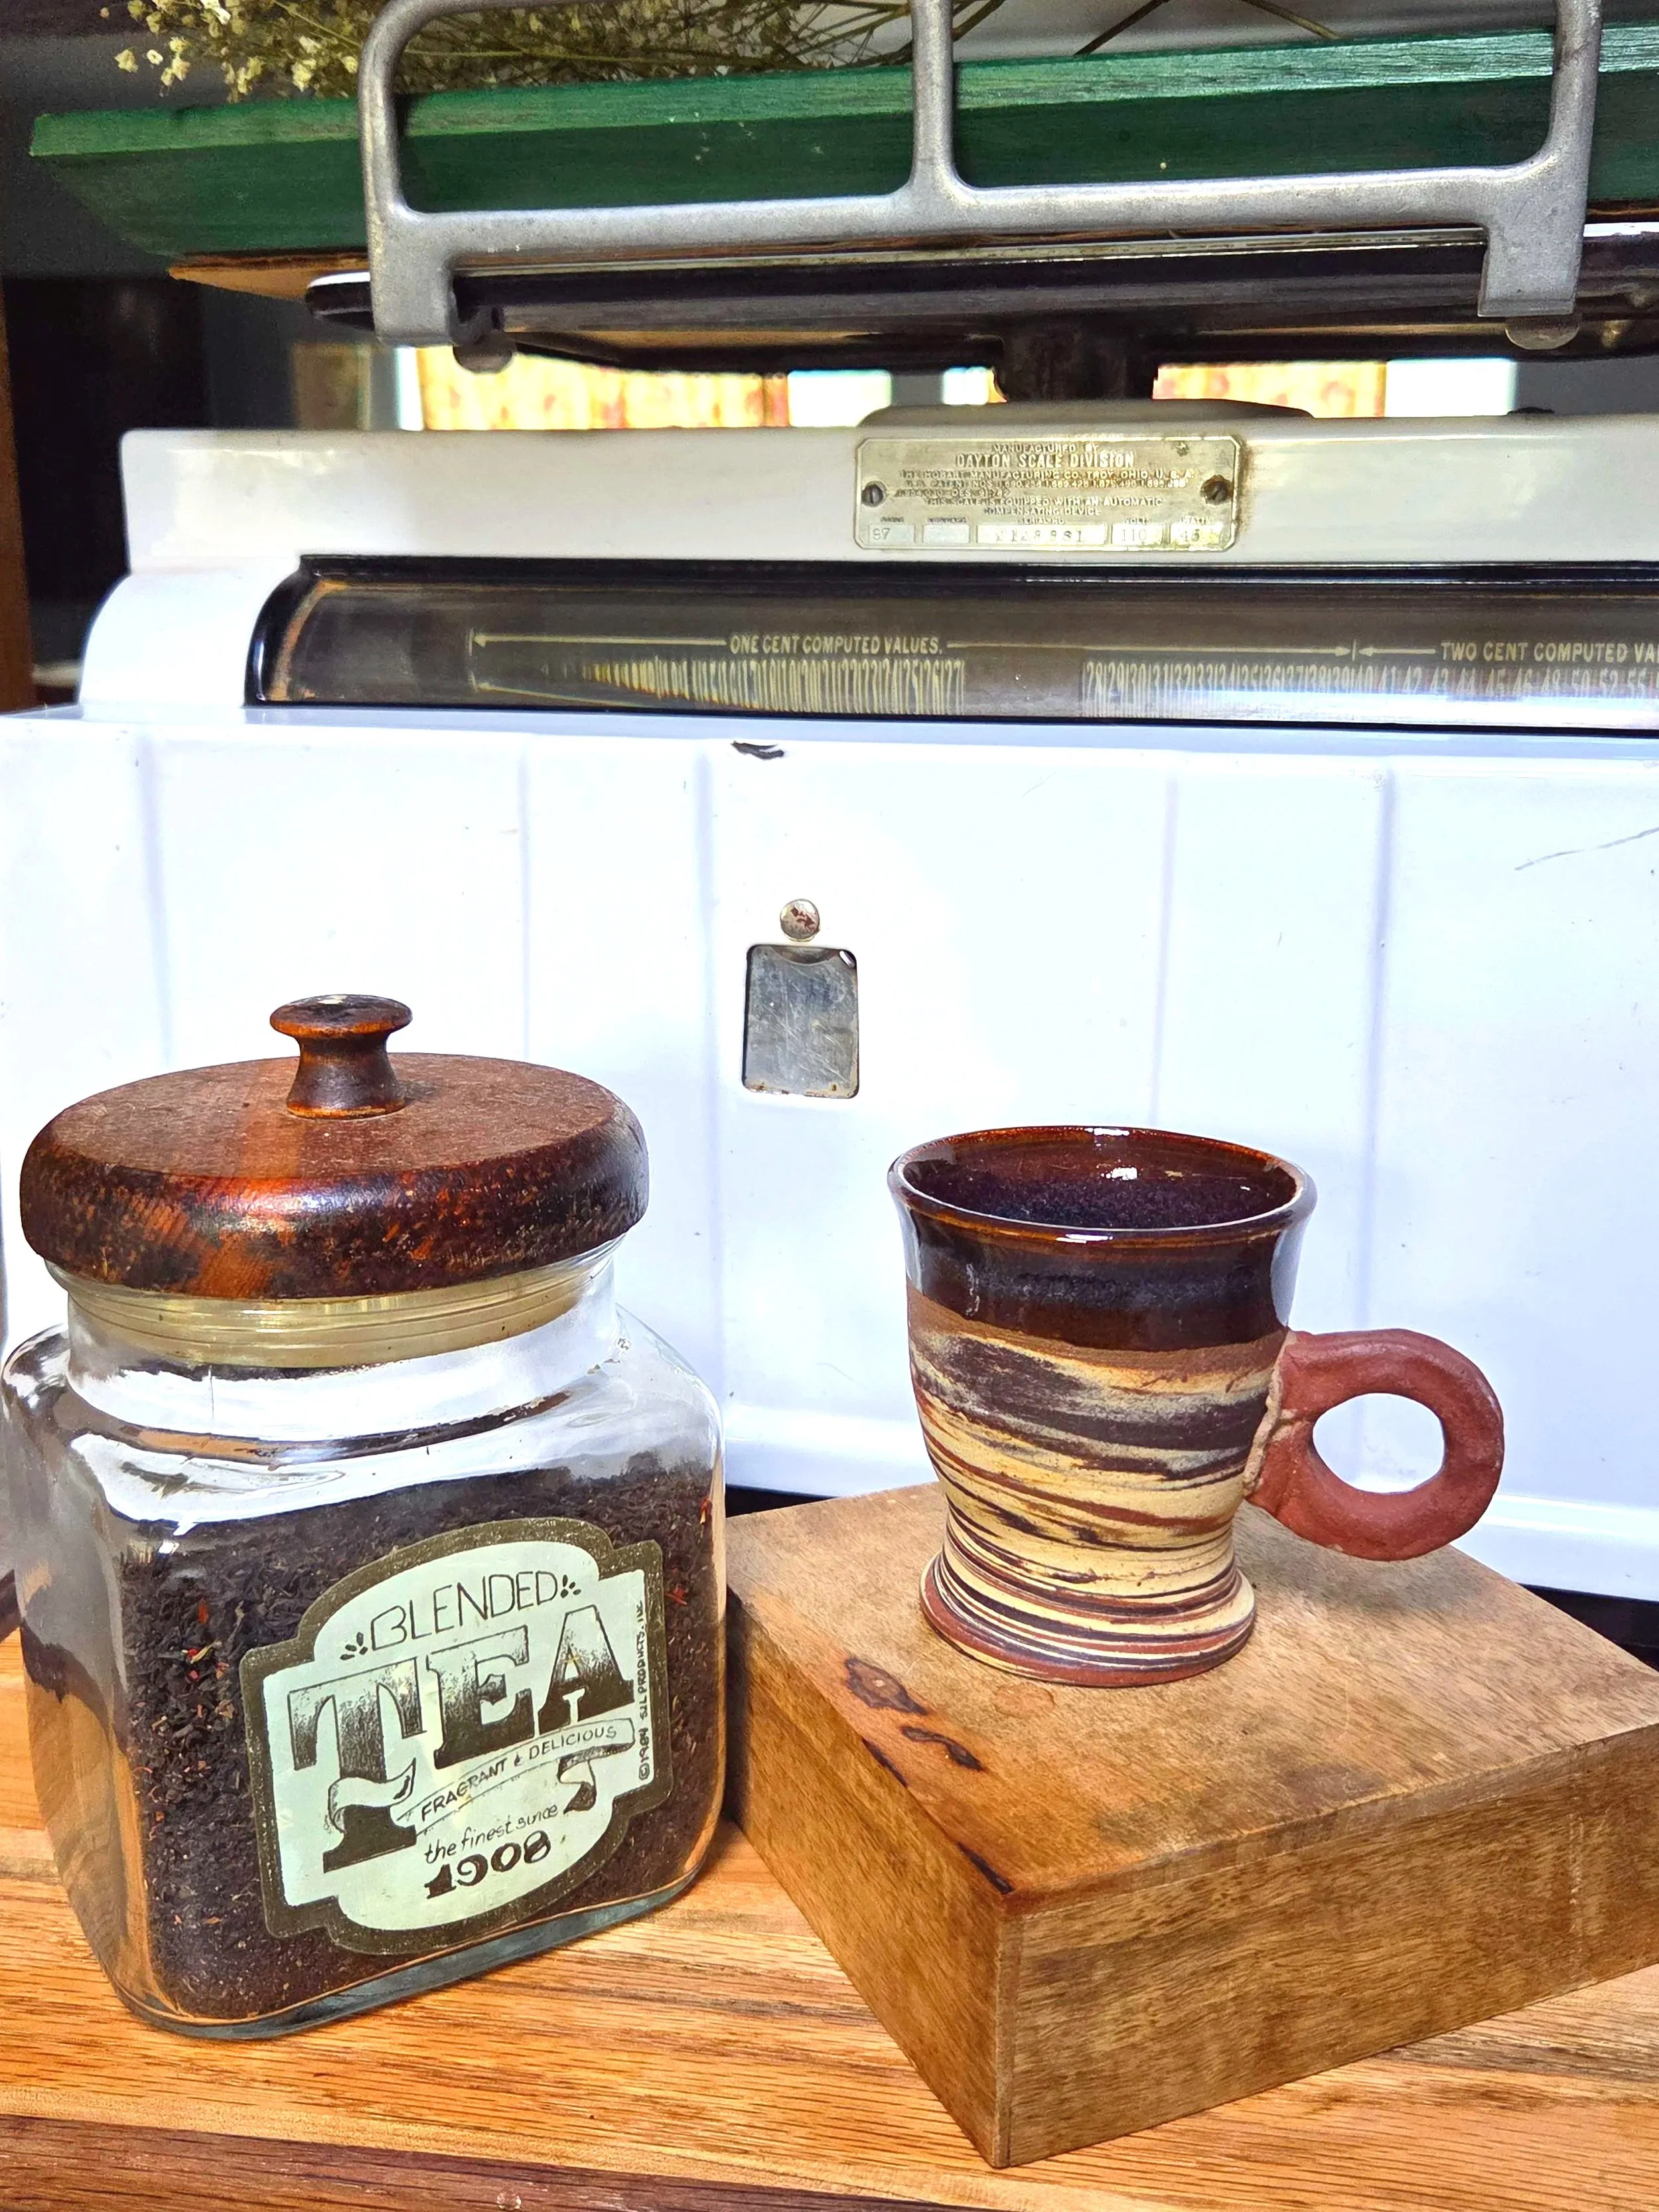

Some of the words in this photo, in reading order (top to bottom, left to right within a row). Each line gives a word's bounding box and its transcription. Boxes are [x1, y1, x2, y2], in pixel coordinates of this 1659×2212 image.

[956, 453, 1010, 468] DAYTON
[1019, 453, 1062, 468] SCALE
[1070, 451, 1134, 468] DIVISION
[924, 470, 966, 479] HOBART
[970, 470, 1060, 480] MANUFACTURING
[983, 506, 1061, 516] COMPENSATING
[1064, 506, 1100, 516] DEVICE
[1000, 497, 1049, 506] EQUIPPED
[1054, 497, 1080, 506] WITH
[1085, 497, 1099, 506] AN
[1103, 497, 1163, 506] AUTOMATIC
[730, 635, 759, 654] ONE
[762, 635, 800, 654] CENT
[802, 636, 879, 655] COMPUTED
[1441, 641, 1477, 661] TWO
[1483, 642, 1528, 662] CENT
[1534, 642, 1628, 663] COMPUTED
[370, 1570, 557, 1651] BLENDED
[287, 1603, 635, 1873] TEA
[421, 1761, 507, 1822] FRAGRANT
[529, 1725, 617, 1762] DELICIOUS
[425, 1837, 457, 1864] the
[460, 1816, 513, 1851] finest
[516, 1803, 559, 1830] since
[423, 1830, 551, 1899] 1908
